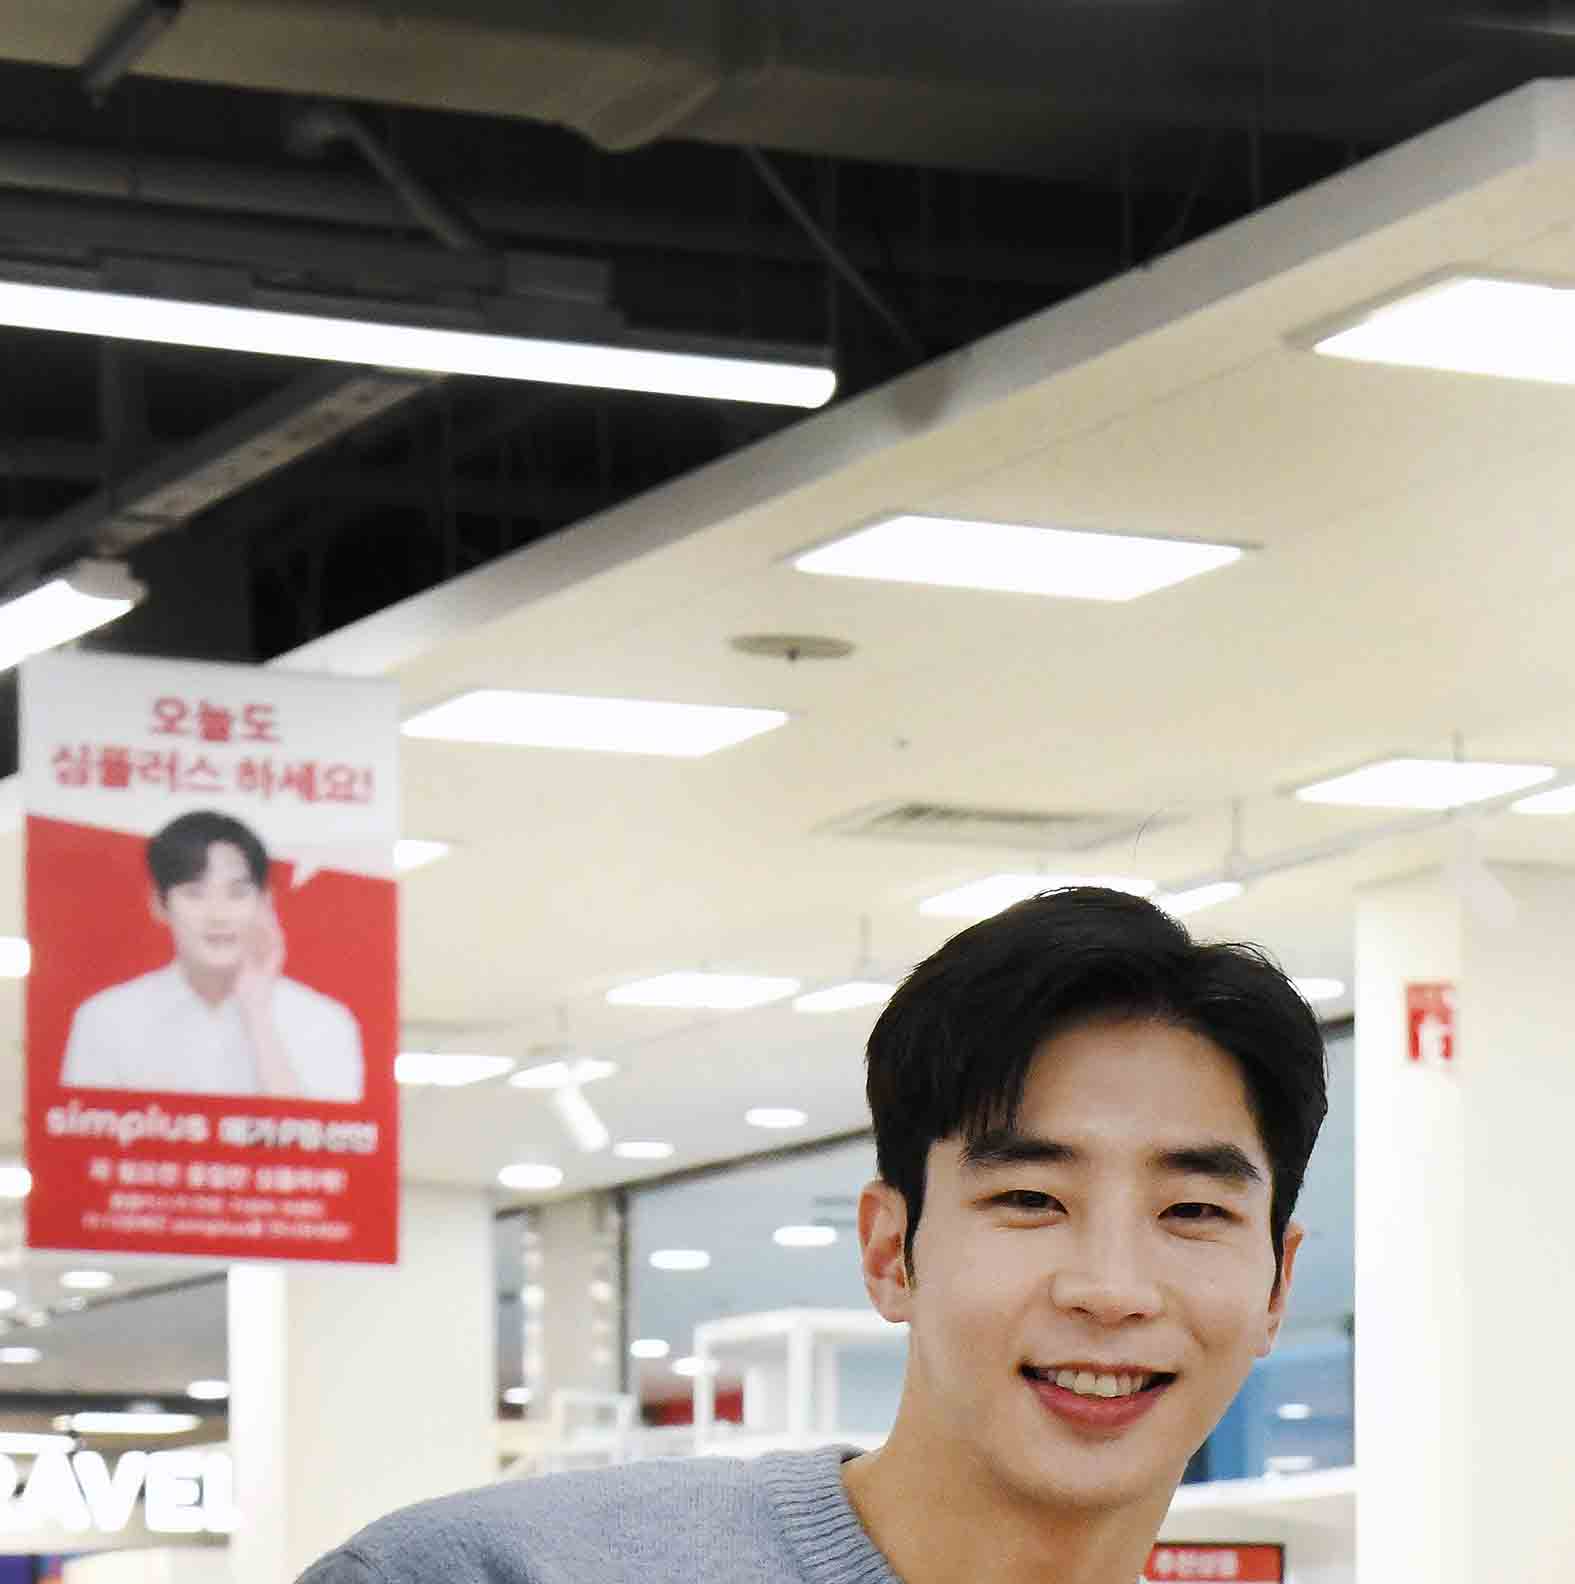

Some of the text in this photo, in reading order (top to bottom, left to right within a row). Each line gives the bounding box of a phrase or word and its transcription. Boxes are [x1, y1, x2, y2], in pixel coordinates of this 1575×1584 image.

[151, 695, 281, 743] 오늘도
[52, 741, 375, 804] 심플러스 하세요!
